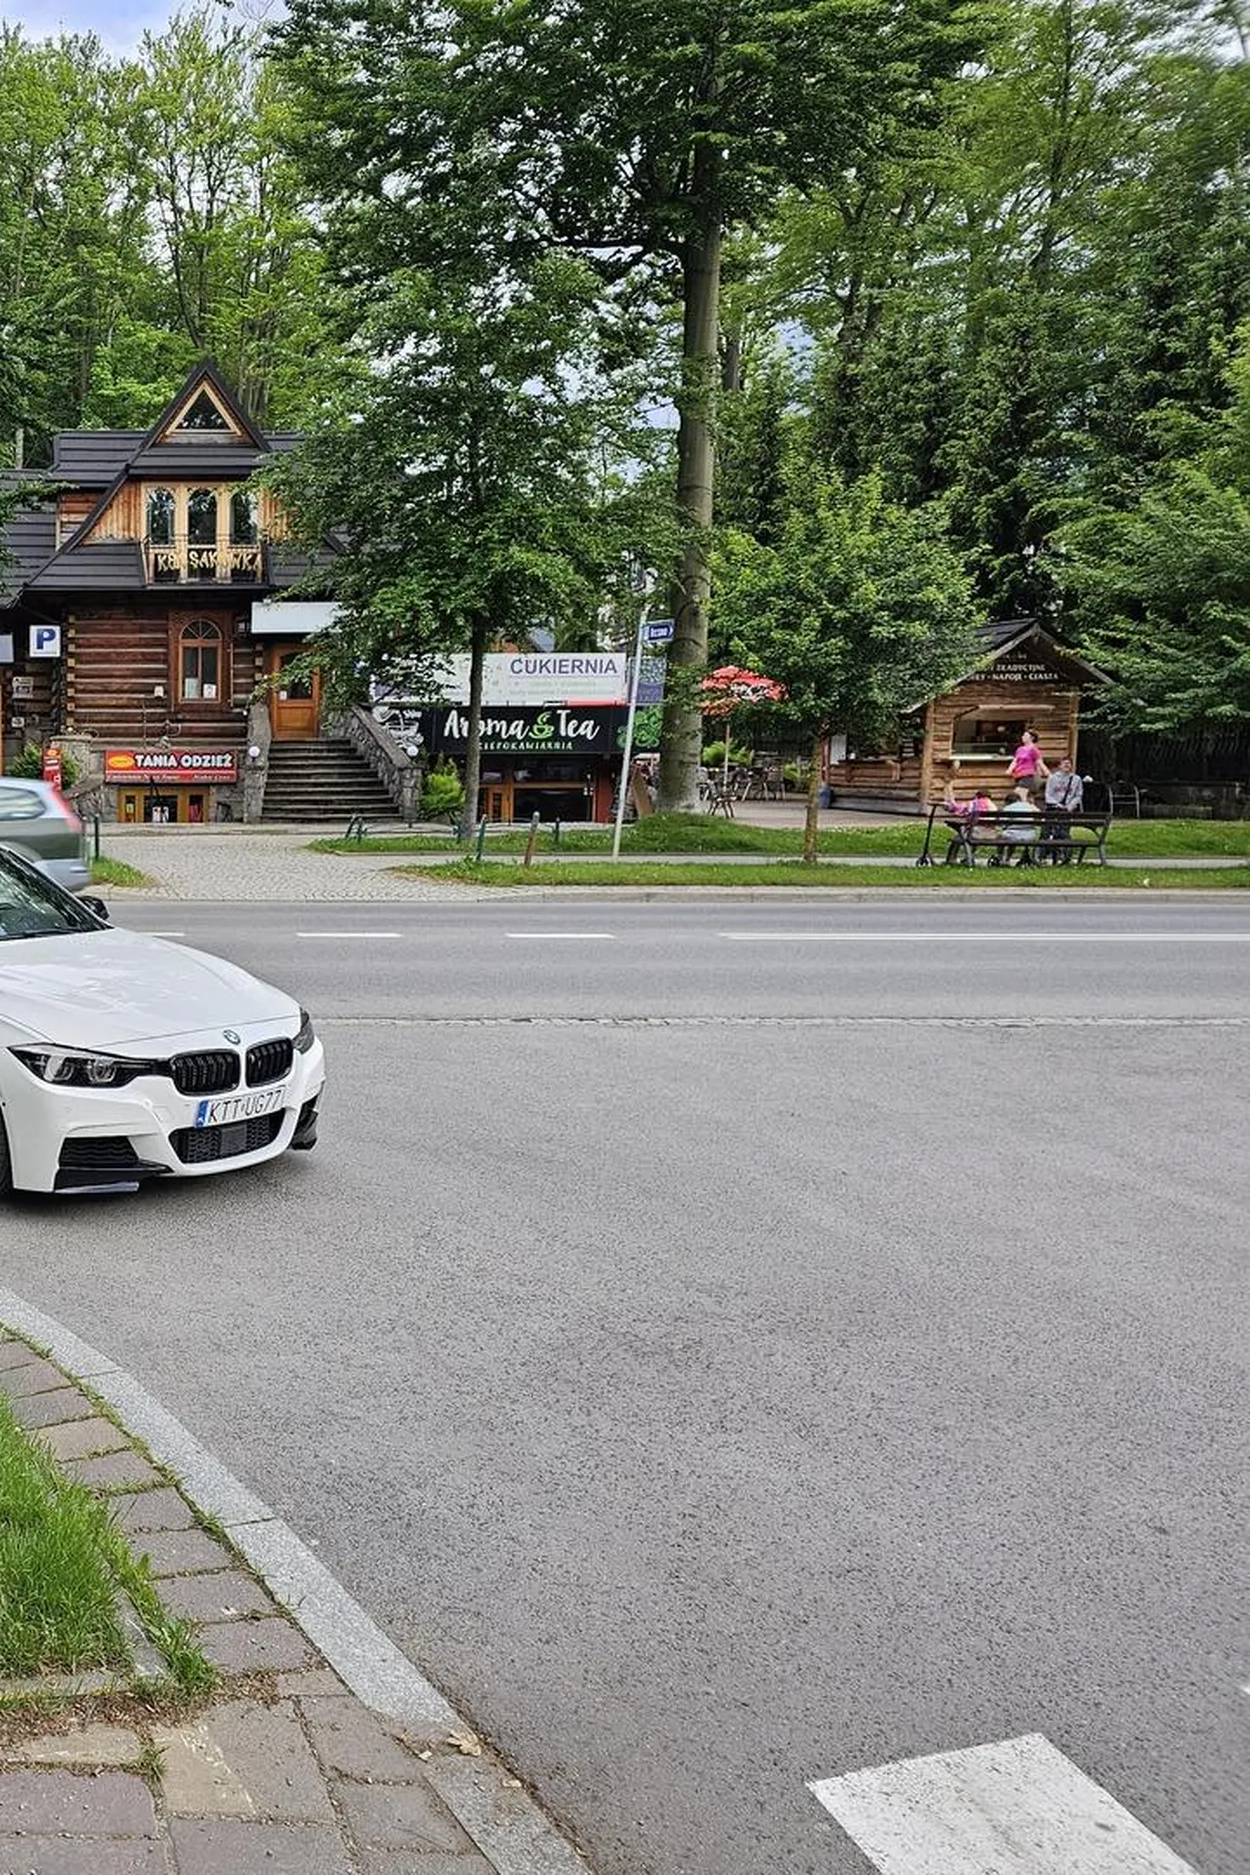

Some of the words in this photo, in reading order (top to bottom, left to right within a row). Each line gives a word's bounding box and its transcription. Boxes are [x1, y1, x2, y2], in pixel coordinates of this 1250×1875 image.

[36, 628, 56, 650] P
[510, 658, 618, 675] CUKIERNIA
[556, 709, 600, 741] Tea
[134, 754, 178, 768] TANIA
